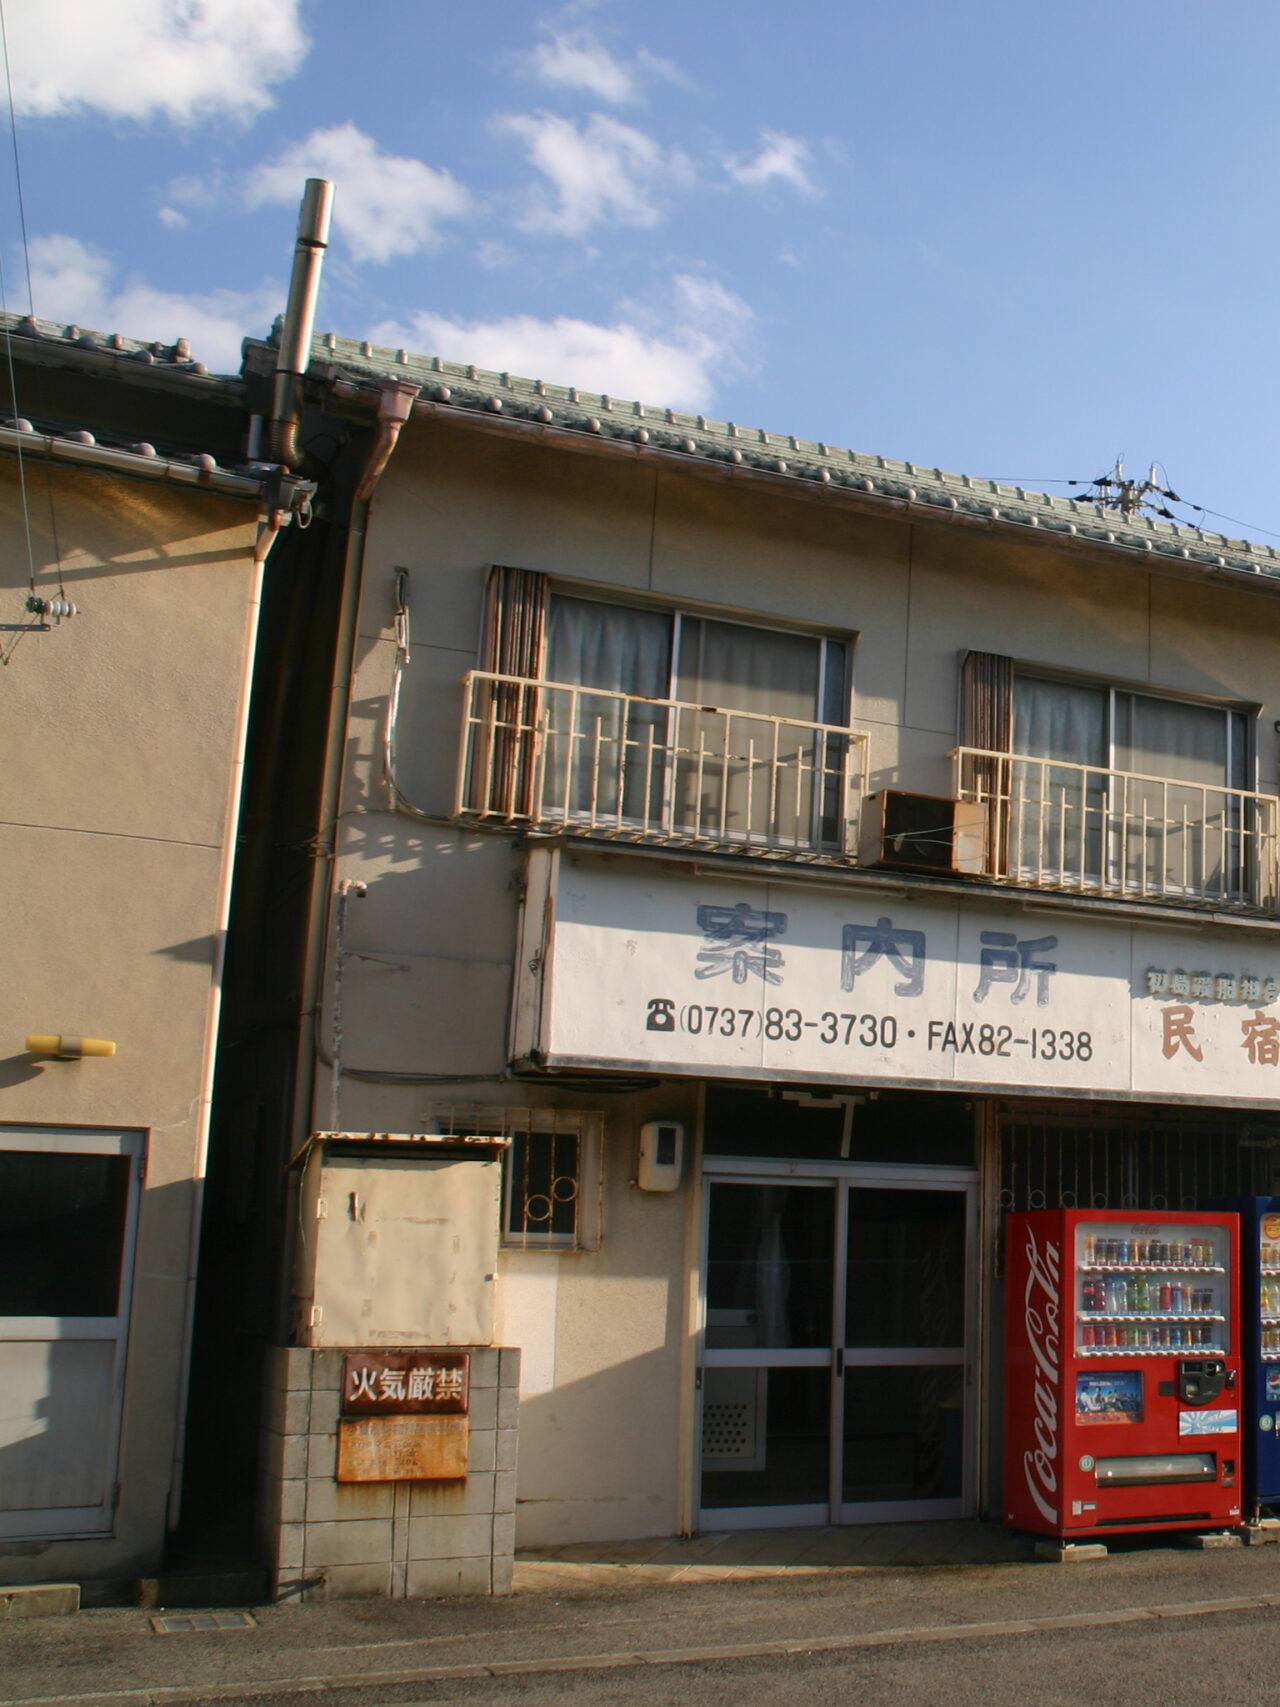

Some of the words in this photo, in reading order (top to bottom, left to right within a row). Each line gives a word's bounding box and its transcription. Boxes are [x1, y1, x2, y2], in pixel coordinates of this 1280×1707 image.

[694, 902, 1060, 1008] 案内所
[679, 1003, 897, 1050] (0737)83-3730
[927, 1020, 1093, 1062] FAX82-1338
[350, 1367, 464, 1401] 火気厳禁
[1024, 1224, 1060, 1524] Coca-Cola
